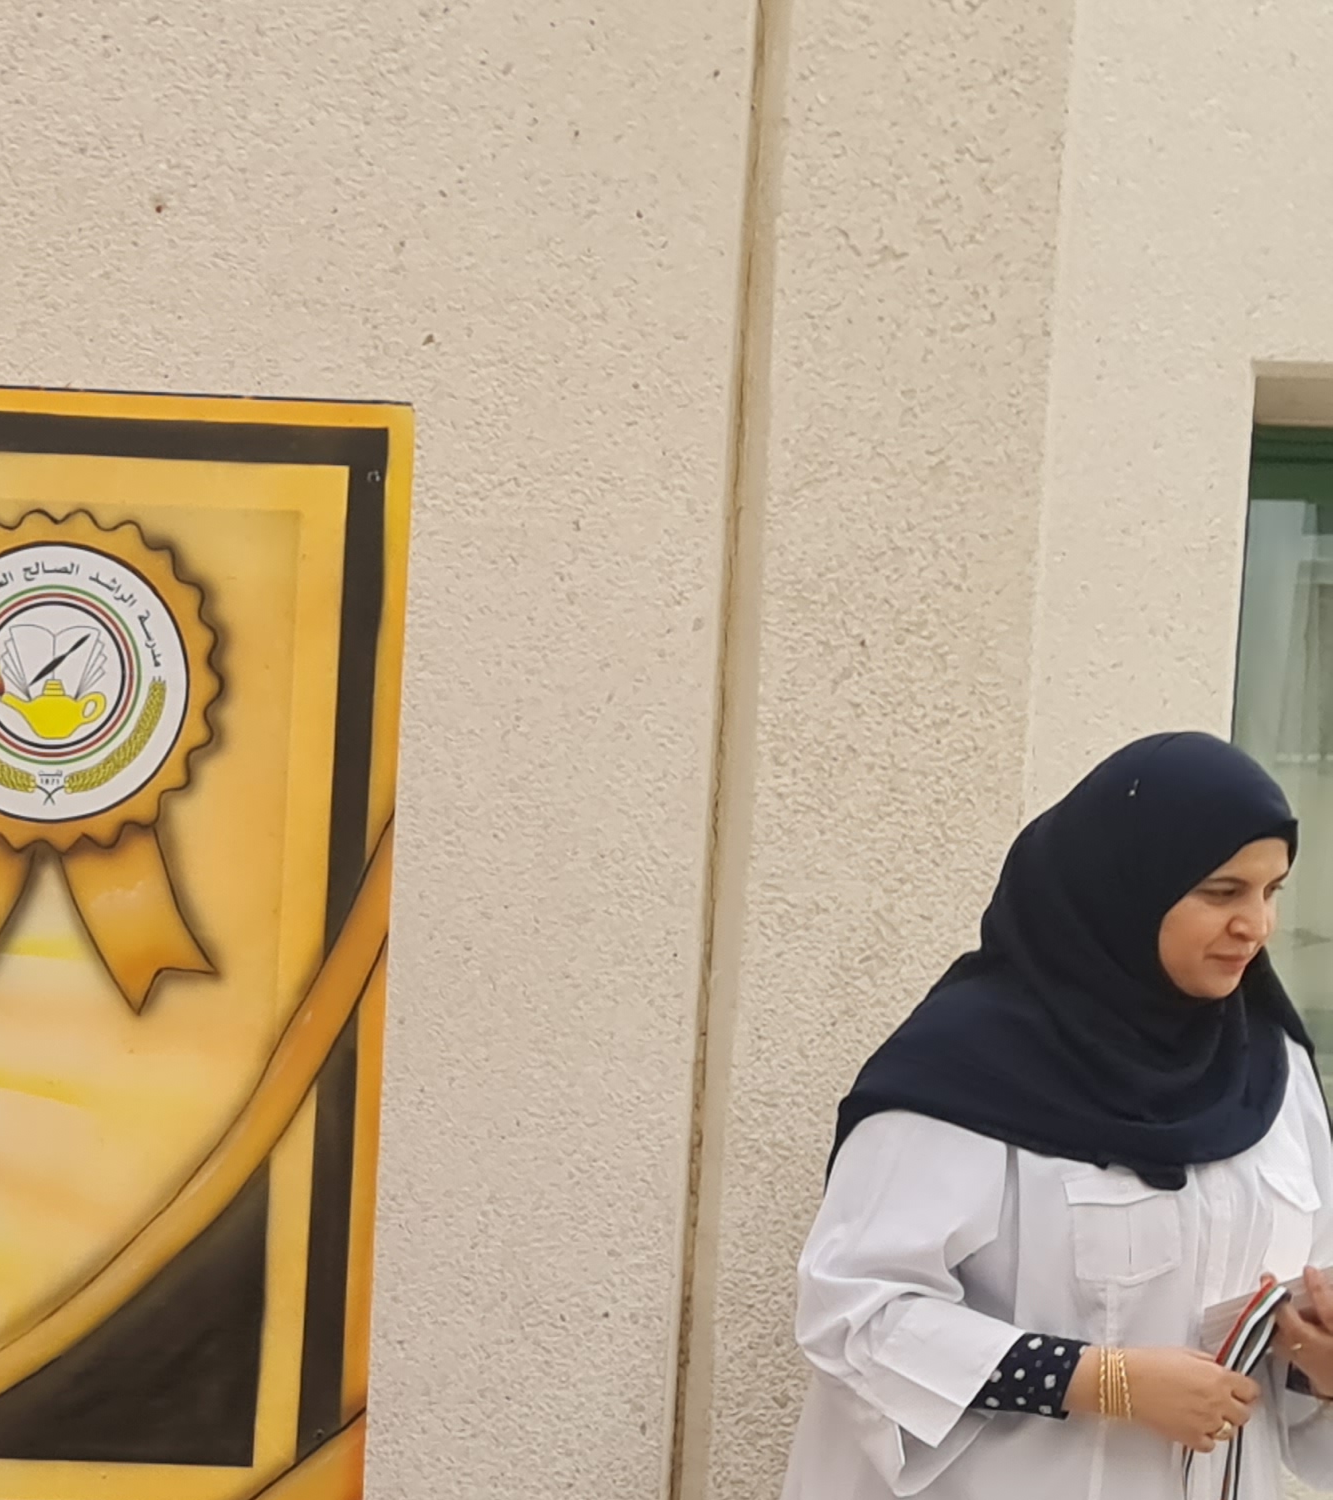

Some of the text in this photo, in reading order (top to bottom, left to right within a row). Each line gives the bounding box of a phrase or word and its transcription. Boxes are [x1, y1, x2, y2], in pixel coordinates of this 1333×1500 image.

[23, 561, 80, 581] الصالح
[89, 572, 137, 607] الراشد
[136, 610, 161, 668] مدرسة
